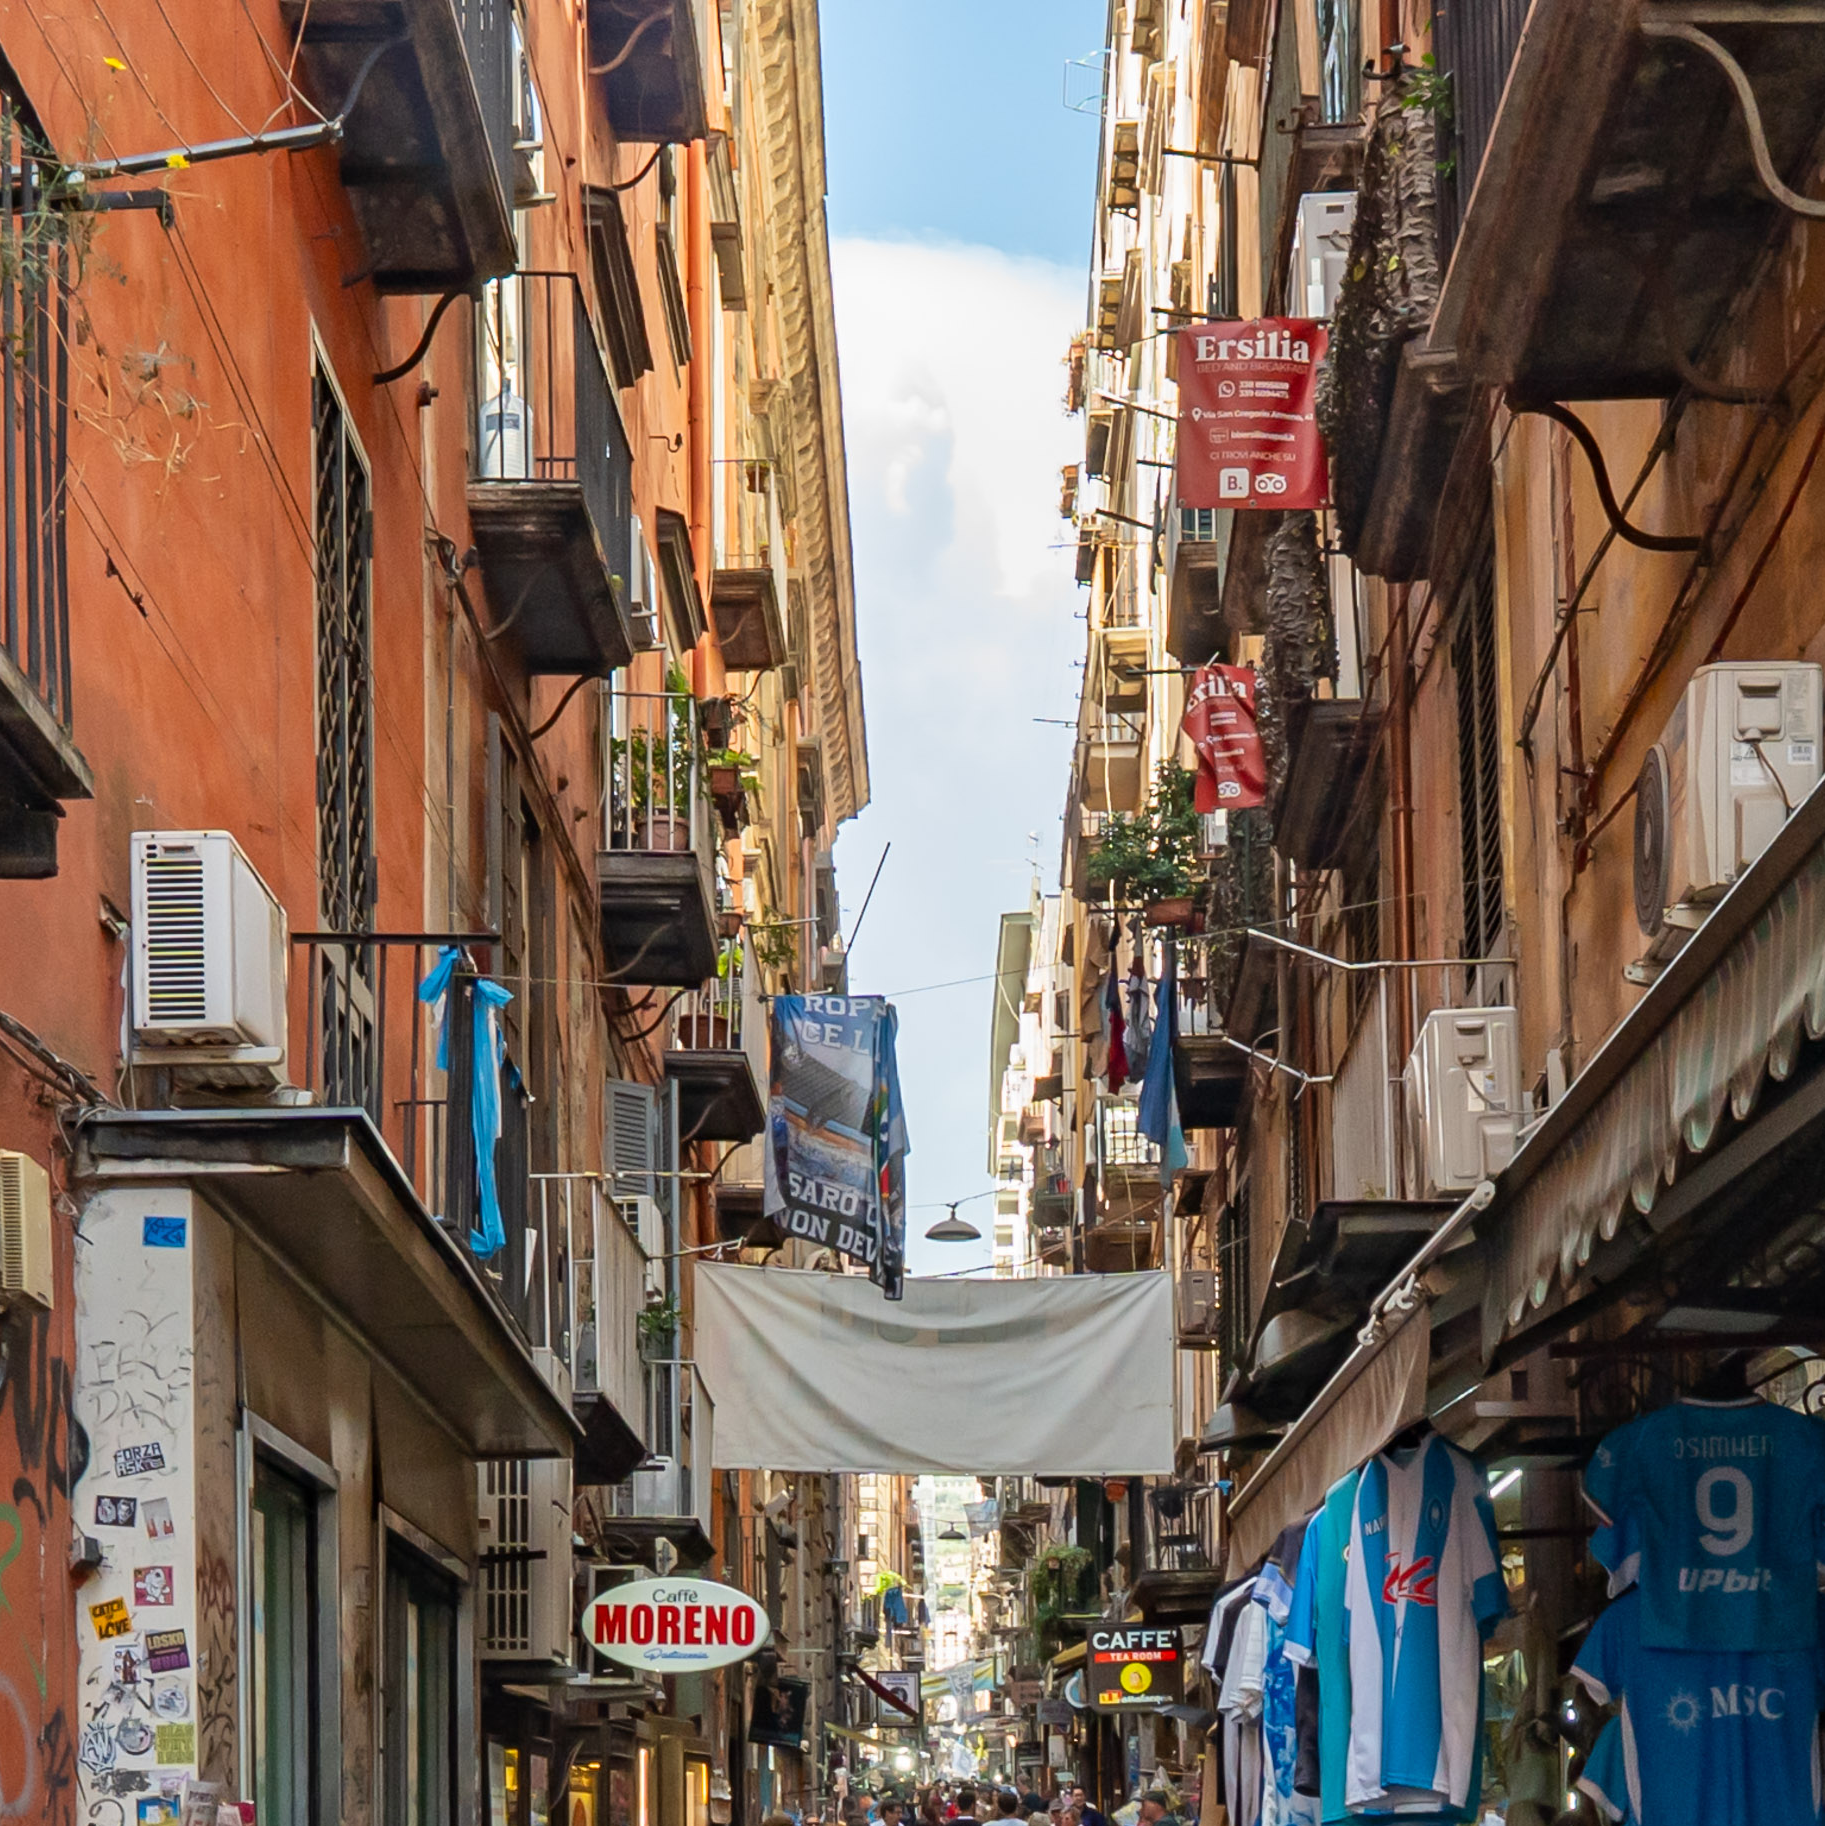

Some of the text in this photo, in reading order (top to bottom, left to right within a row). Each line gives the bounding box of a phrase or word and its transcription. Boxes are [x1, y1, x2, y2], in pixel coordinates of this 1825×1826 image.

[1195, 330, 1310, 363] Ersilia
[1222, 361, 1248, 372] AND
[116, 1442, 162, 1462] FORZA
[1696, 1466, 1754, 1556] 9
[99, 1617, 131, 1639] LOVE
[595, 1604, 755, 1646] MORENO
[1092, 1629, 1178, 1651] CAFFE'
[1110, 1651, 1162, 1662] TEA ROOM
[1710, 1683, 1786, 1721] MSC
